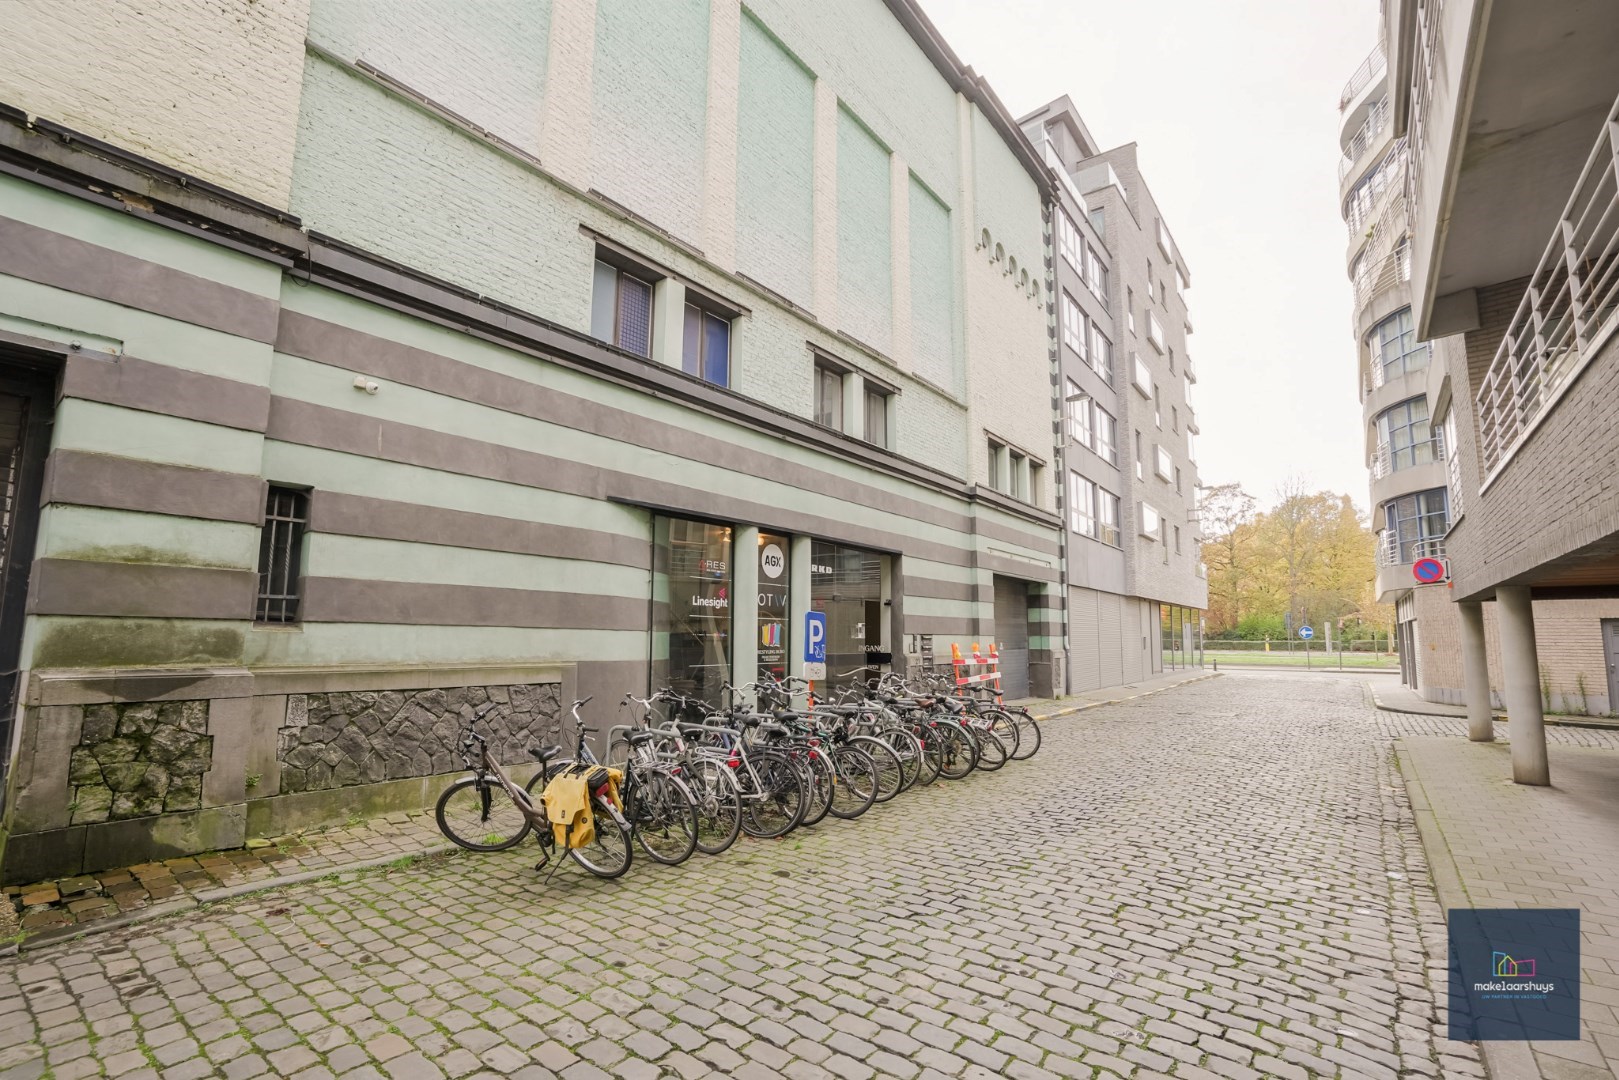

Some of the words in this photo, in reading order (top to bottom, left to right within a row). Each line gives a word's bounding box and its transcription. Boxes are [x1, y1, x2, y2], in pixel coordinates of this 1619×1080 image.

[764, 554, 782, 568] AGX
[692, 595, 728, 609] Linesight
[808, 619, 824, 655] P
[858, 644, 885, 652] INGANG
